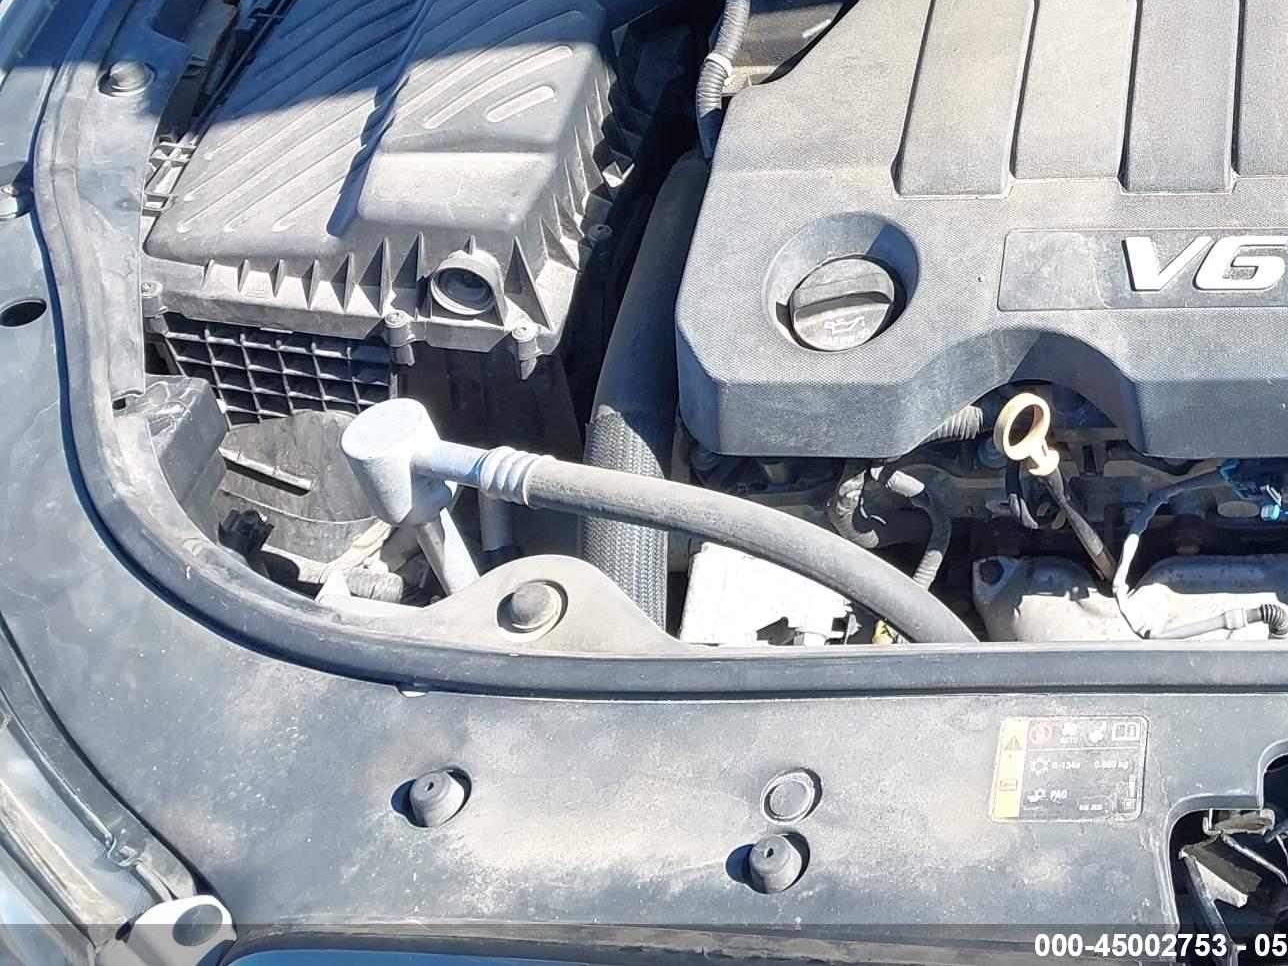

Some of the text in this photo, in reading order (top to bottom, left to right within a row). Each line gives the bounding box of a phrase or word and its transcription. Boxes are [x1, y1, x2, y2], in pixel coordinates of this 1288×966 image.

[1121, 236, 1288, 293] V6
[1059, 736, 1079, 744] AUTO
[1118, 760, 1129, 769] kg
[1050, 789, 1068, 799] PAG
